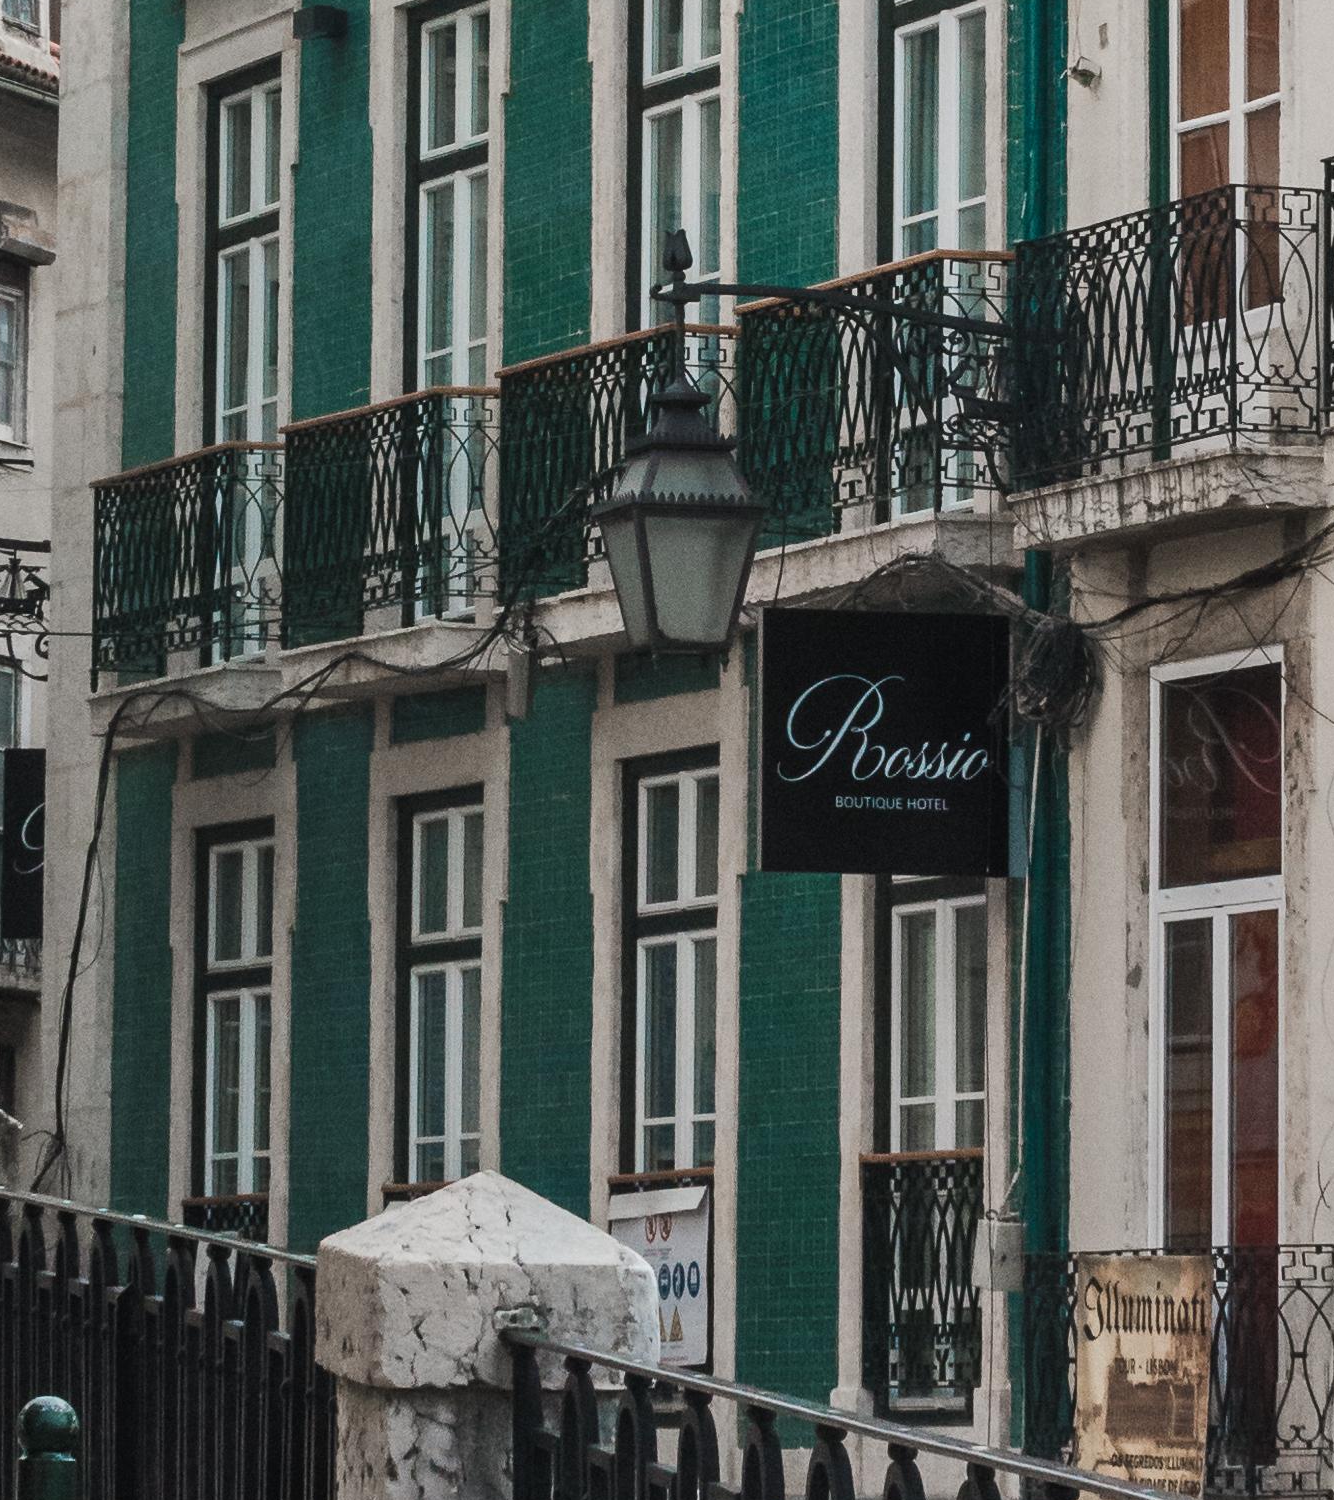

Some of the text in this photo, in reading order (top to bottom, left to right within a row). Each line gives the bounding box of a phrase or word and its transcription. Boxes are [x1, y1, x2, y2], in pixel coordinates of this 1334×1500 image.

[777, 674, 994, 782] Rossio
[835, 796, 949, 811] BOUTIQUE HOTEL
[1083, 1276, 1207, 1341] Illuminati
